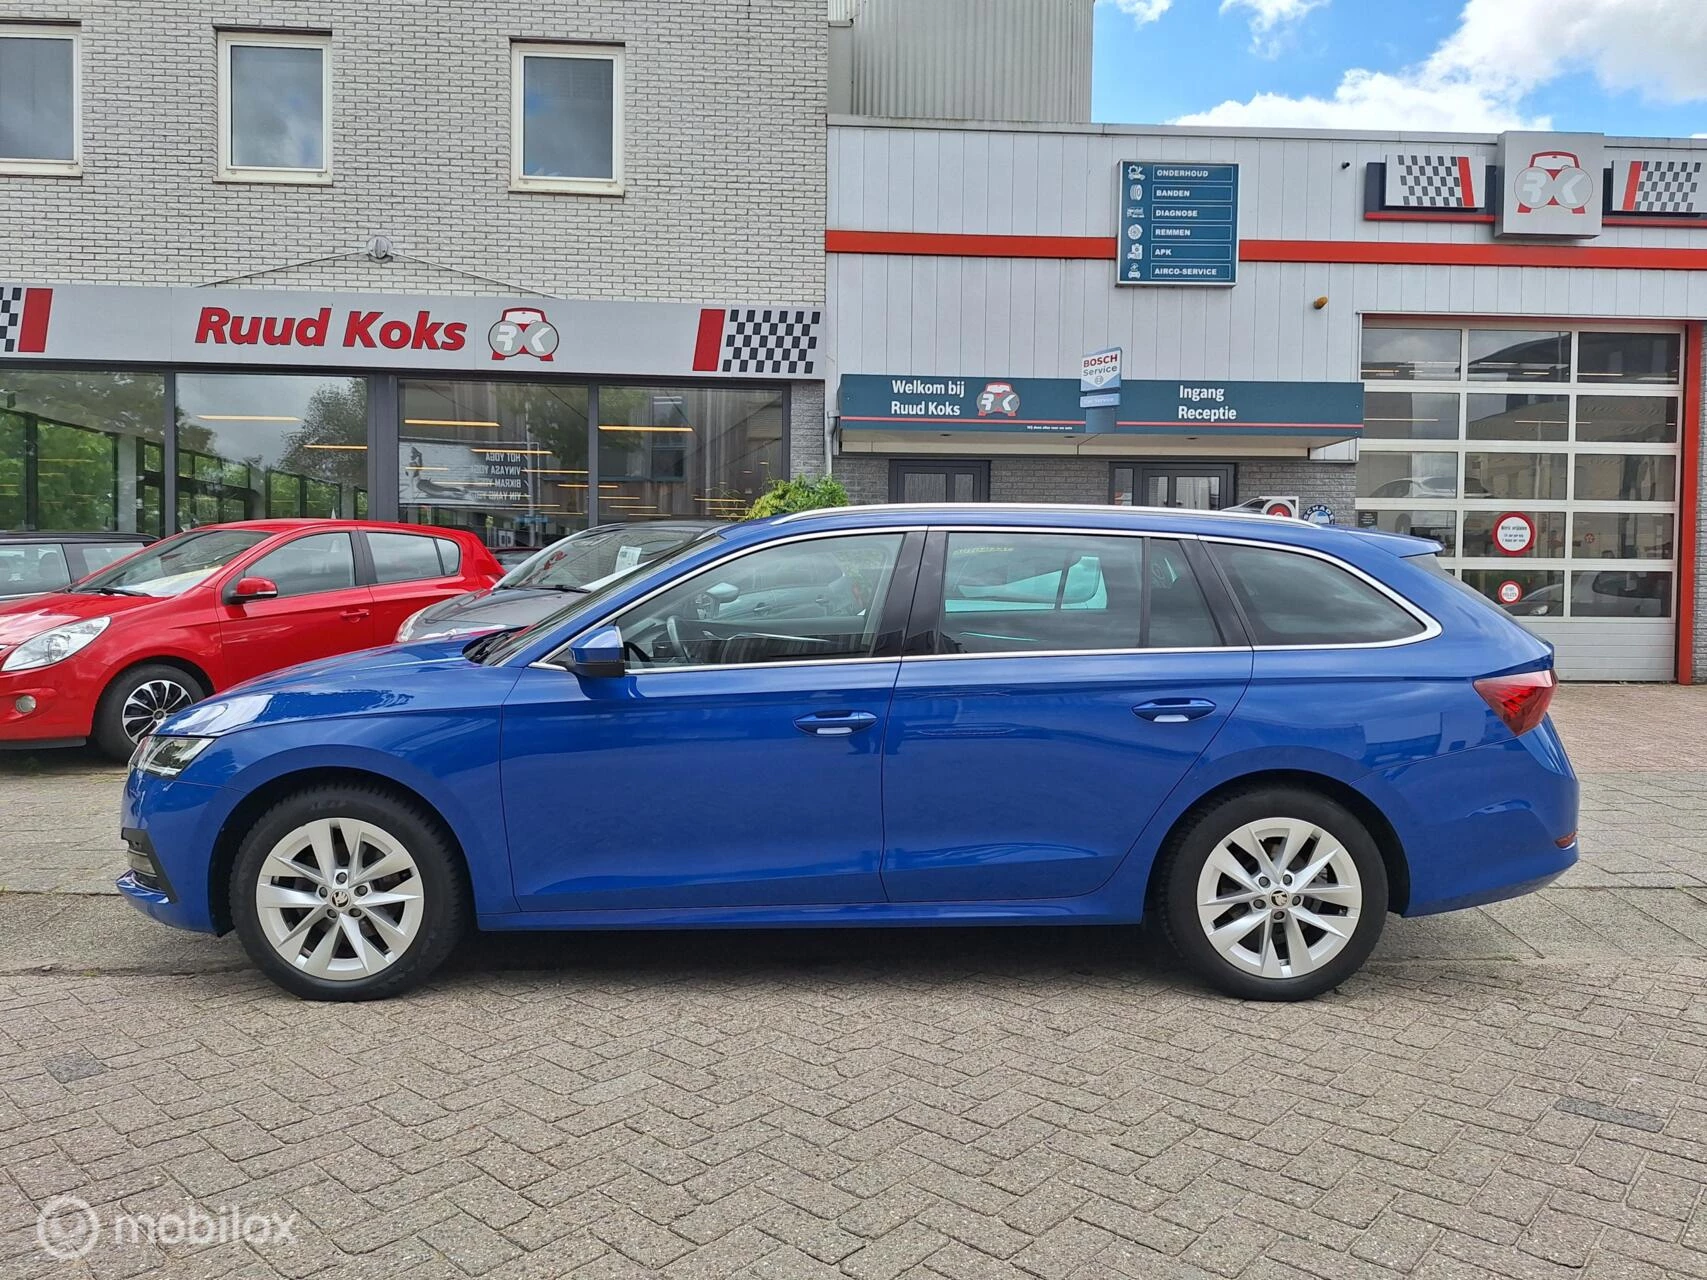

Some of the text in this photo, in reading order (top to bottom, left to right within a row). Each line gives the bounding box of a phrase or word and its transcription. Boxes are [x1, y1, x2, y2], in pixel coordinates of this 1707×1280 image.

[1156, 169, 1208, 178] ONDERHOUD
[1154, 248, 1172, 256] APK
[195, 305, 468, 351] Ruud Koks
[1083, 353, 1119, 369] BOSCH
[1083, 365, 1118, 377] Service
[892, 380, 965, 398] Welkom bij
[1179, 384, 1225, 402] Ingang
[890, 400, 961, 416] Ruud Koks
[1178, 405, 1237, 422] Receptie
[1303, 505, 1335, 521] SCHADE
